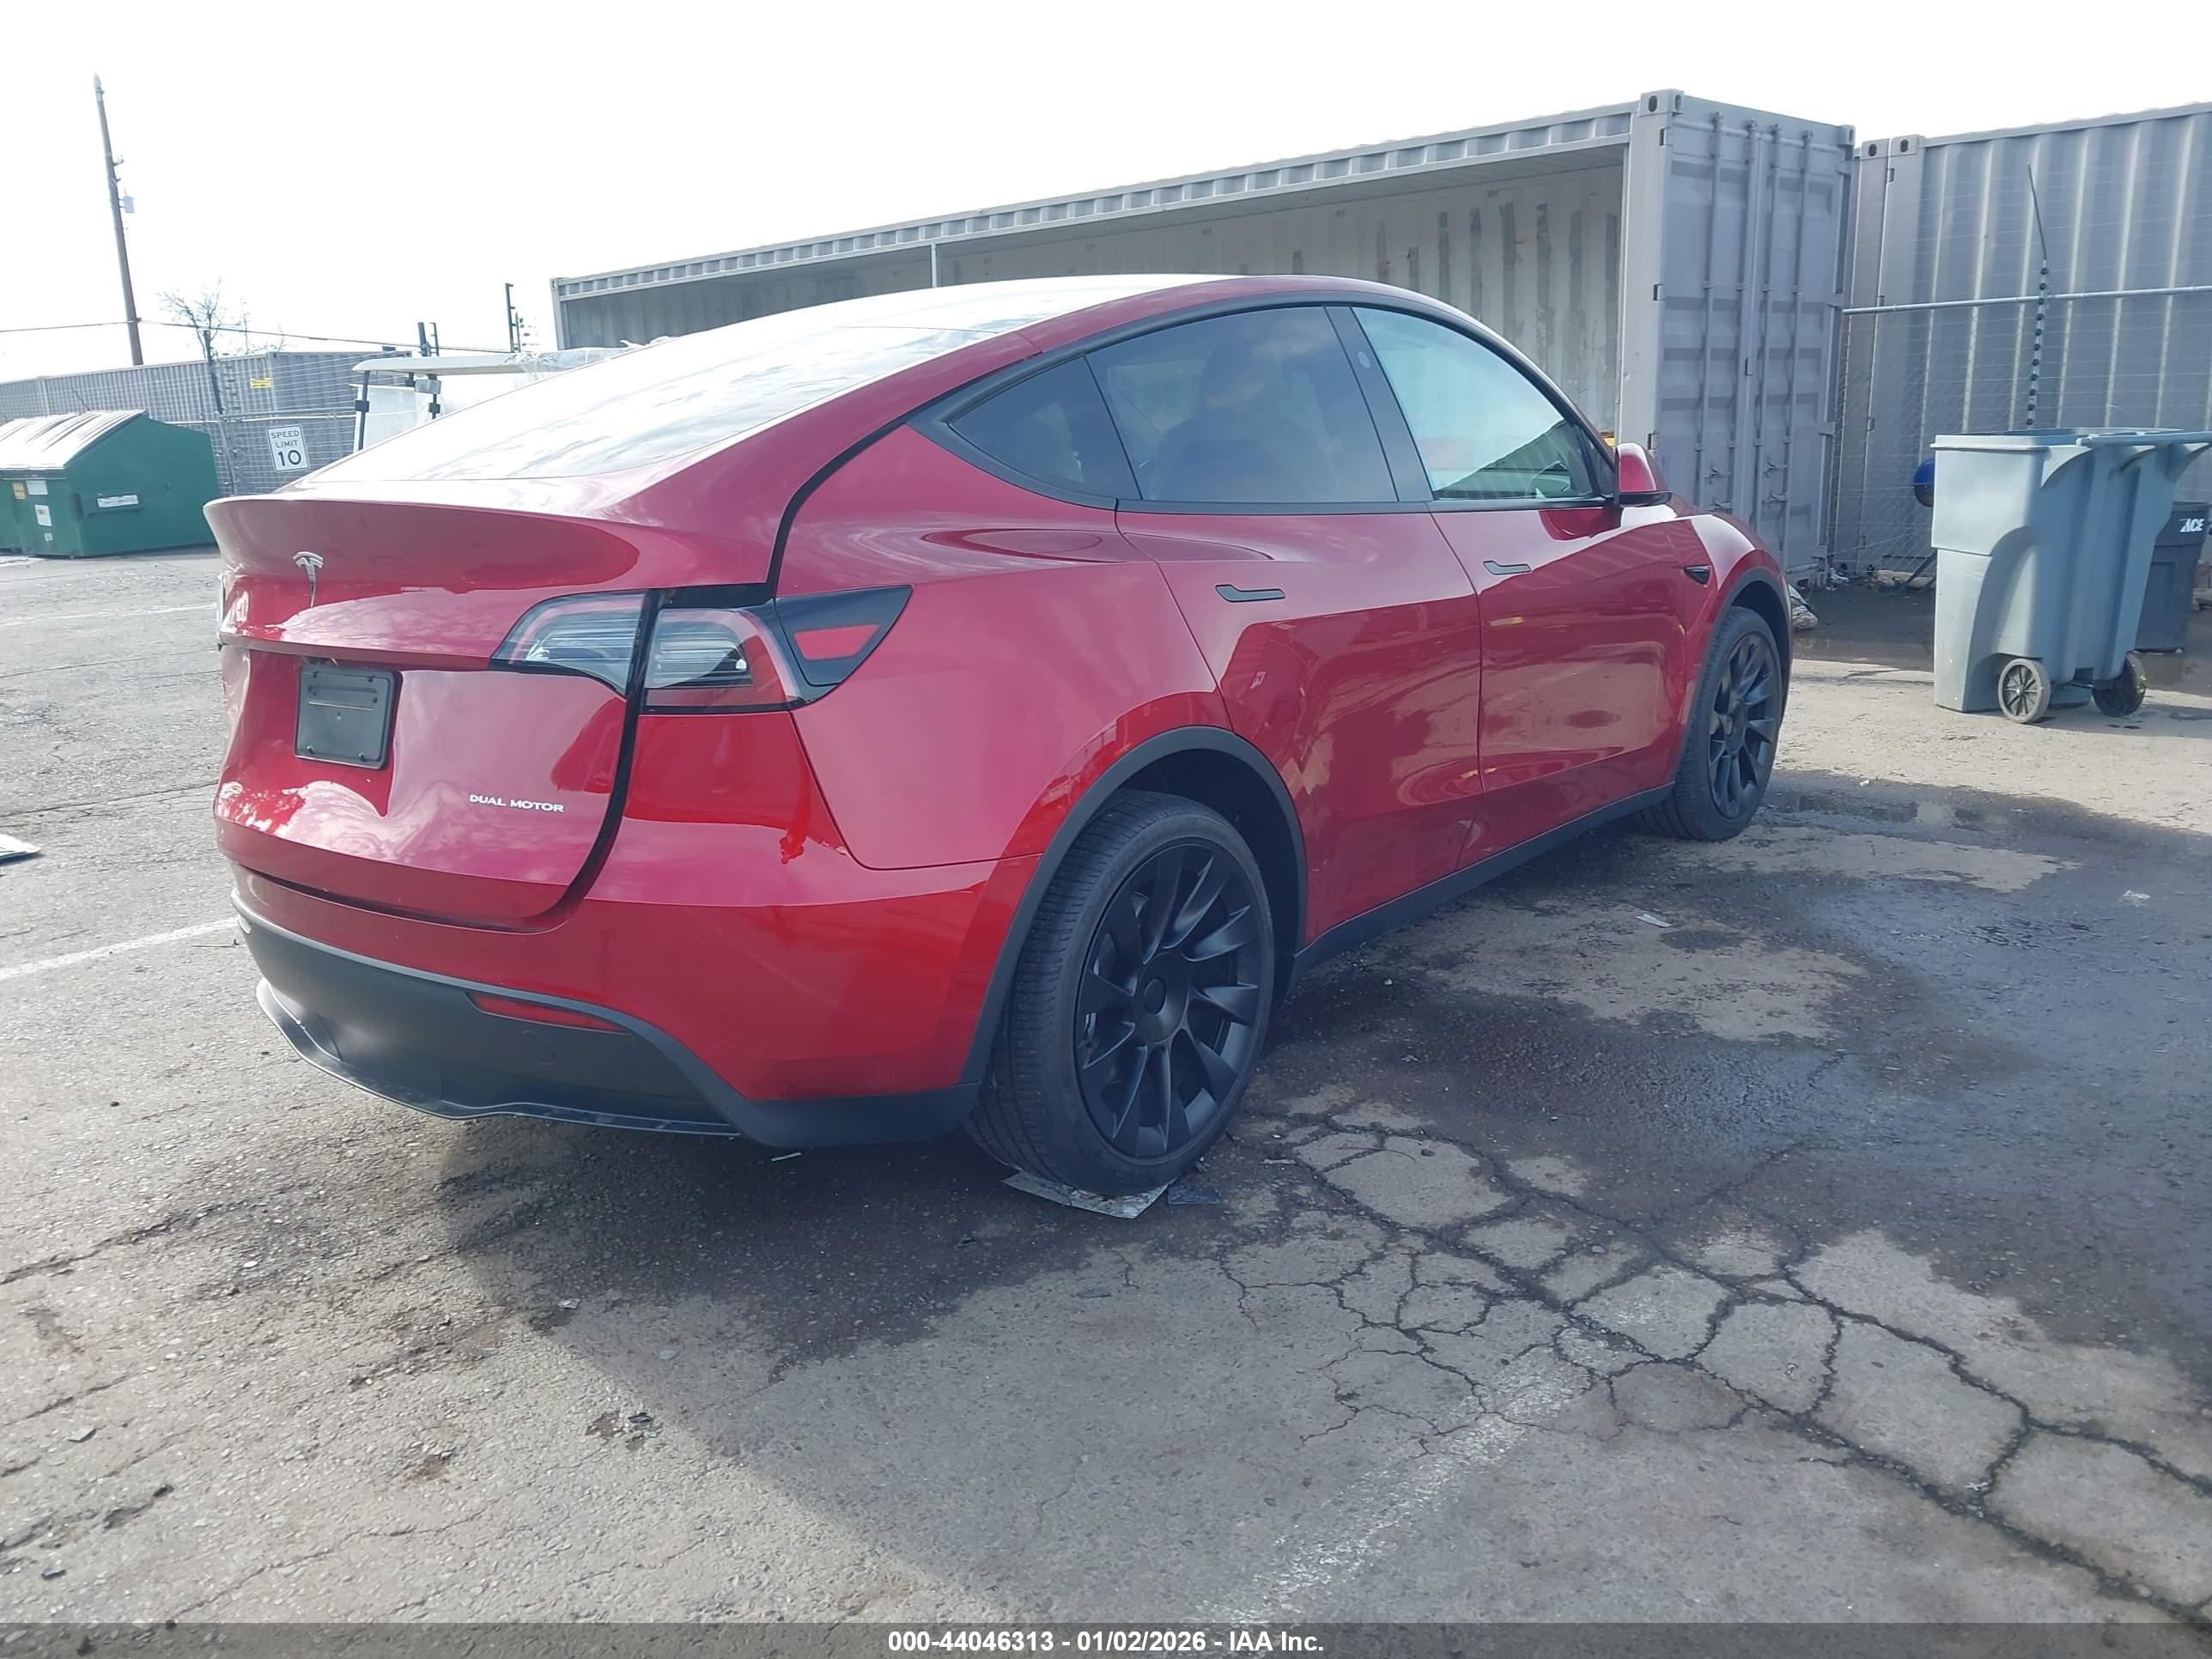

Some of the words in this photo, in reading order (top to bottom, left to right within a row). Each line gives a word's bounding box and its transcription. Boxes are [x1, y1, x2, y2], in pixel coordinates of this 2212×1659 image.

[270, 430, 300, 439] SPEED
[278, 450, 301, 466] 10
[2179, 518, 2205, 532] ACE
[469, 794, 507, 806] DUAL
[510, 799, 564, 812] MOTOR
